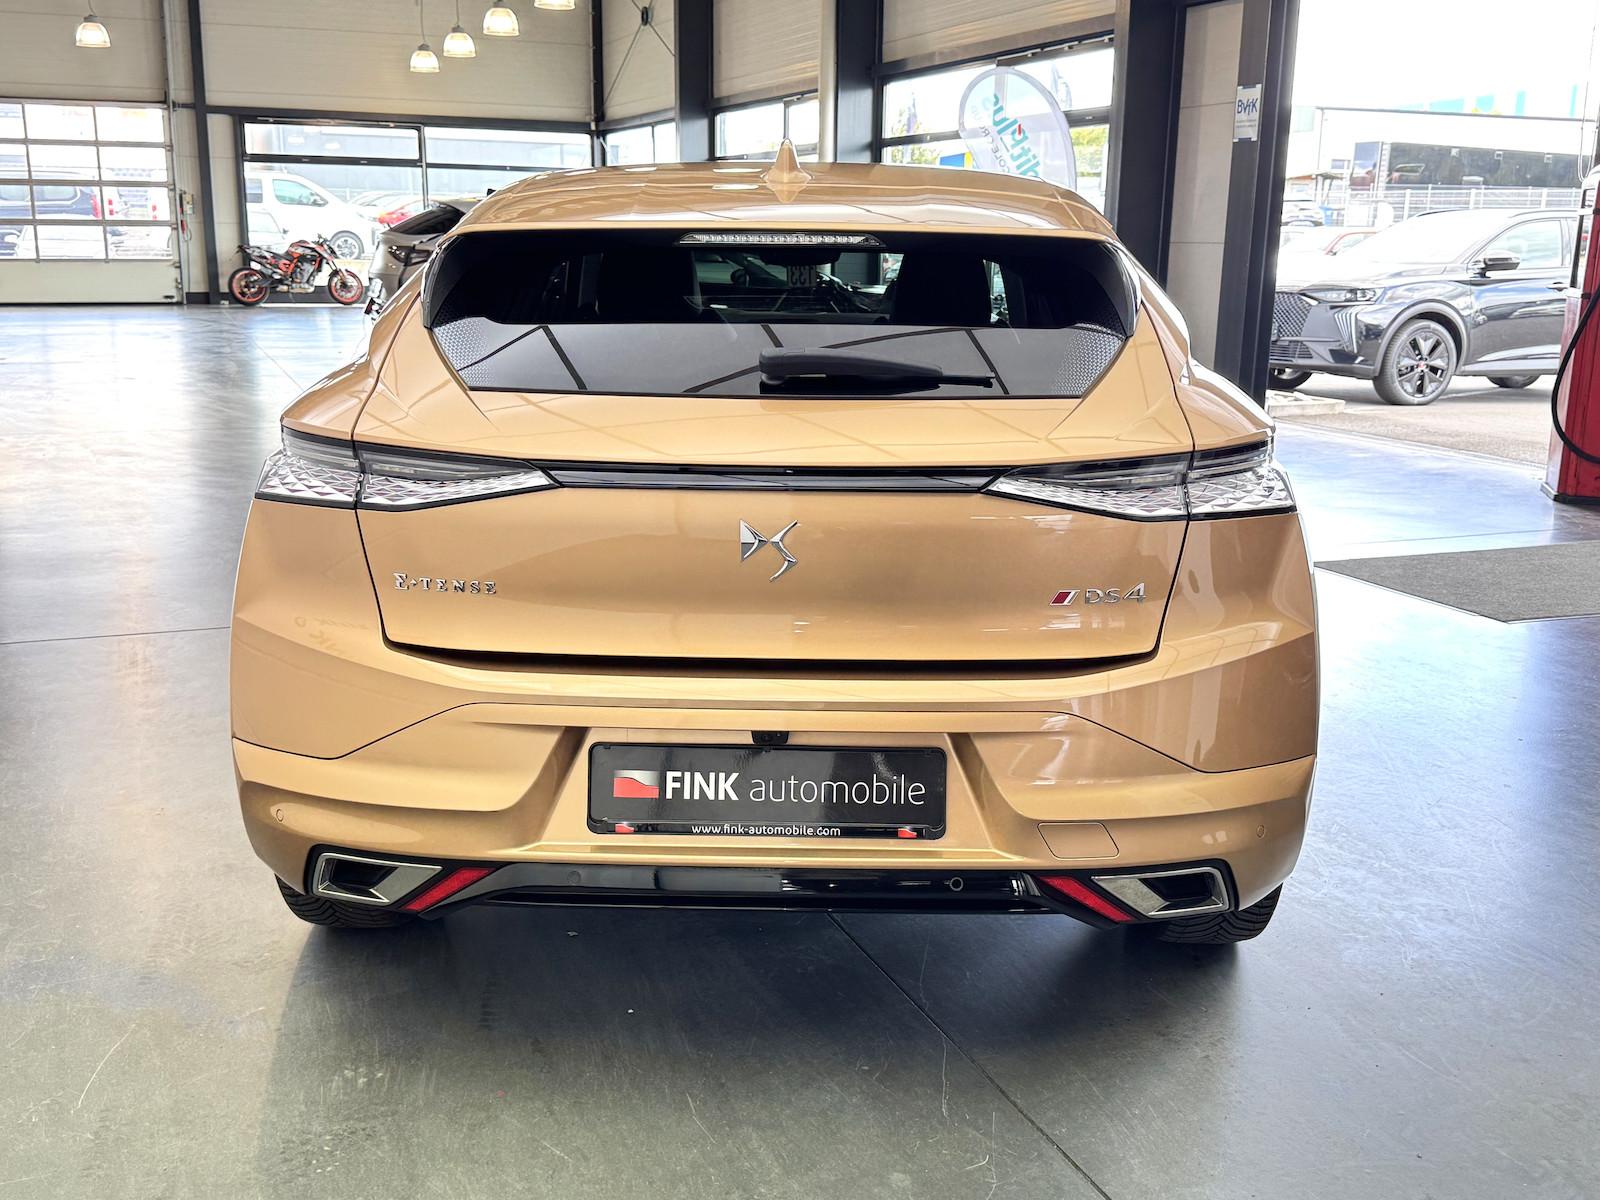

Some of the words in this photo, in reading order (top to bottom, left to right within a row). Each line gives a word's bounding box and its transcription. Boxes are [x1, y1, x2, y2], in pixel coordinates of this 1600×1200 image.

[392, 572, 497, 594] E-TENSE
[665, 771, 740, 801] FINK
[749, 773, 926, 805] automobile
[691, 823, 841, 836] www.fink-automobile.com
